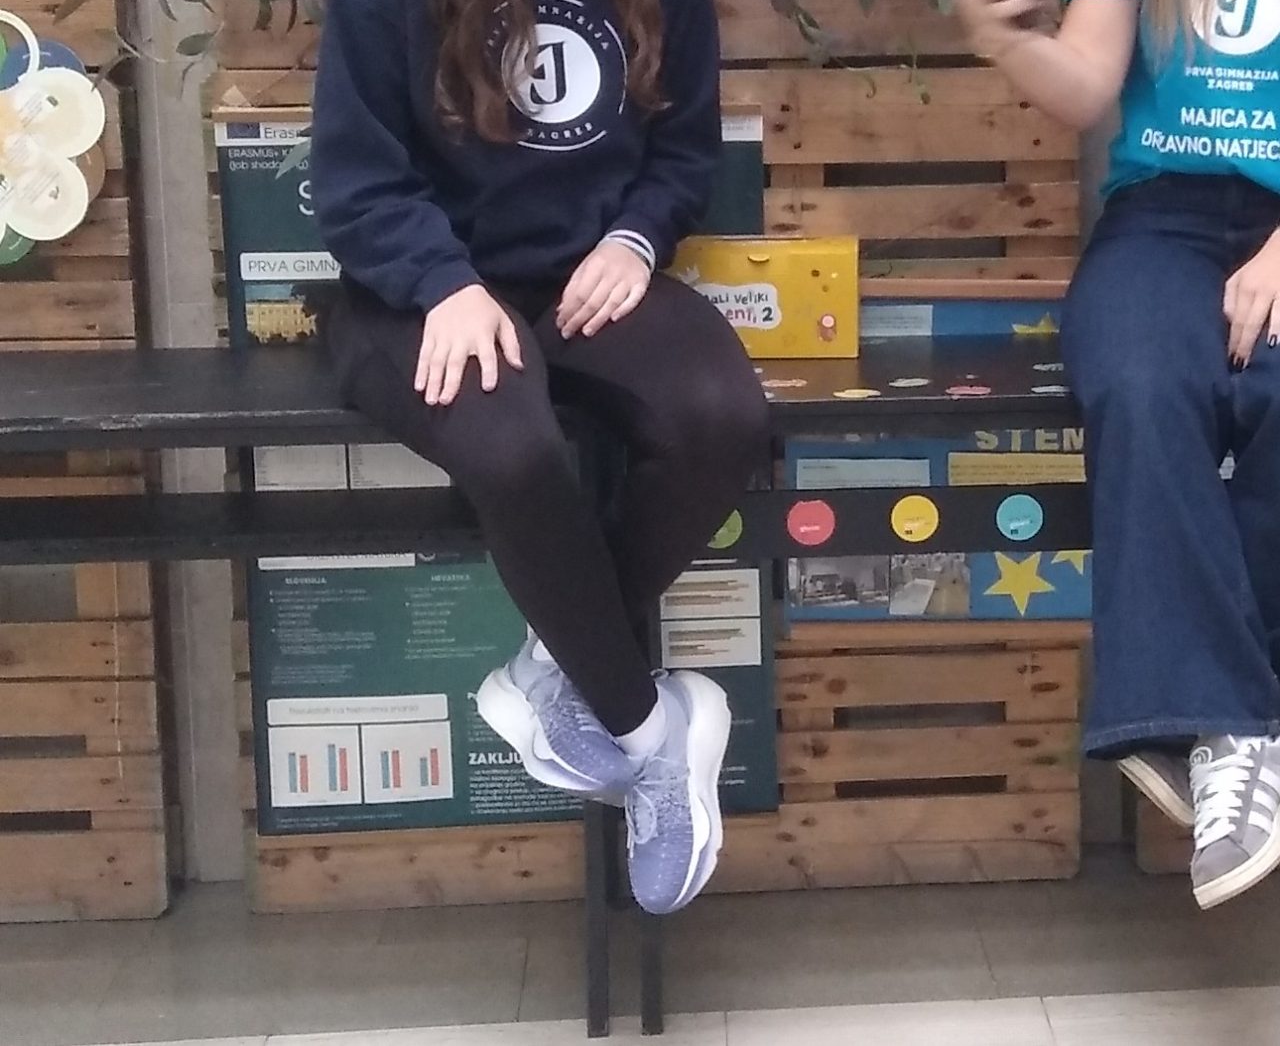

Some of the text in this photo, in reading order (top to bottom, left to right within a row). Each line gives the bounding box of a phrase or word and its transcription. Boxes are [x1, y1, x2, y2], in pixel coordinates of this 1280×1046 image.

[1185, 66, 1279, 80] PRVA GIMNAZIJA
[1207, 78, 1254, 91] ZAGREB
[1181, 107, 1276, 130] MAJICA ZA
[248, 260, 289, 273] PRVA
[762, 307, 774, 322] 2
